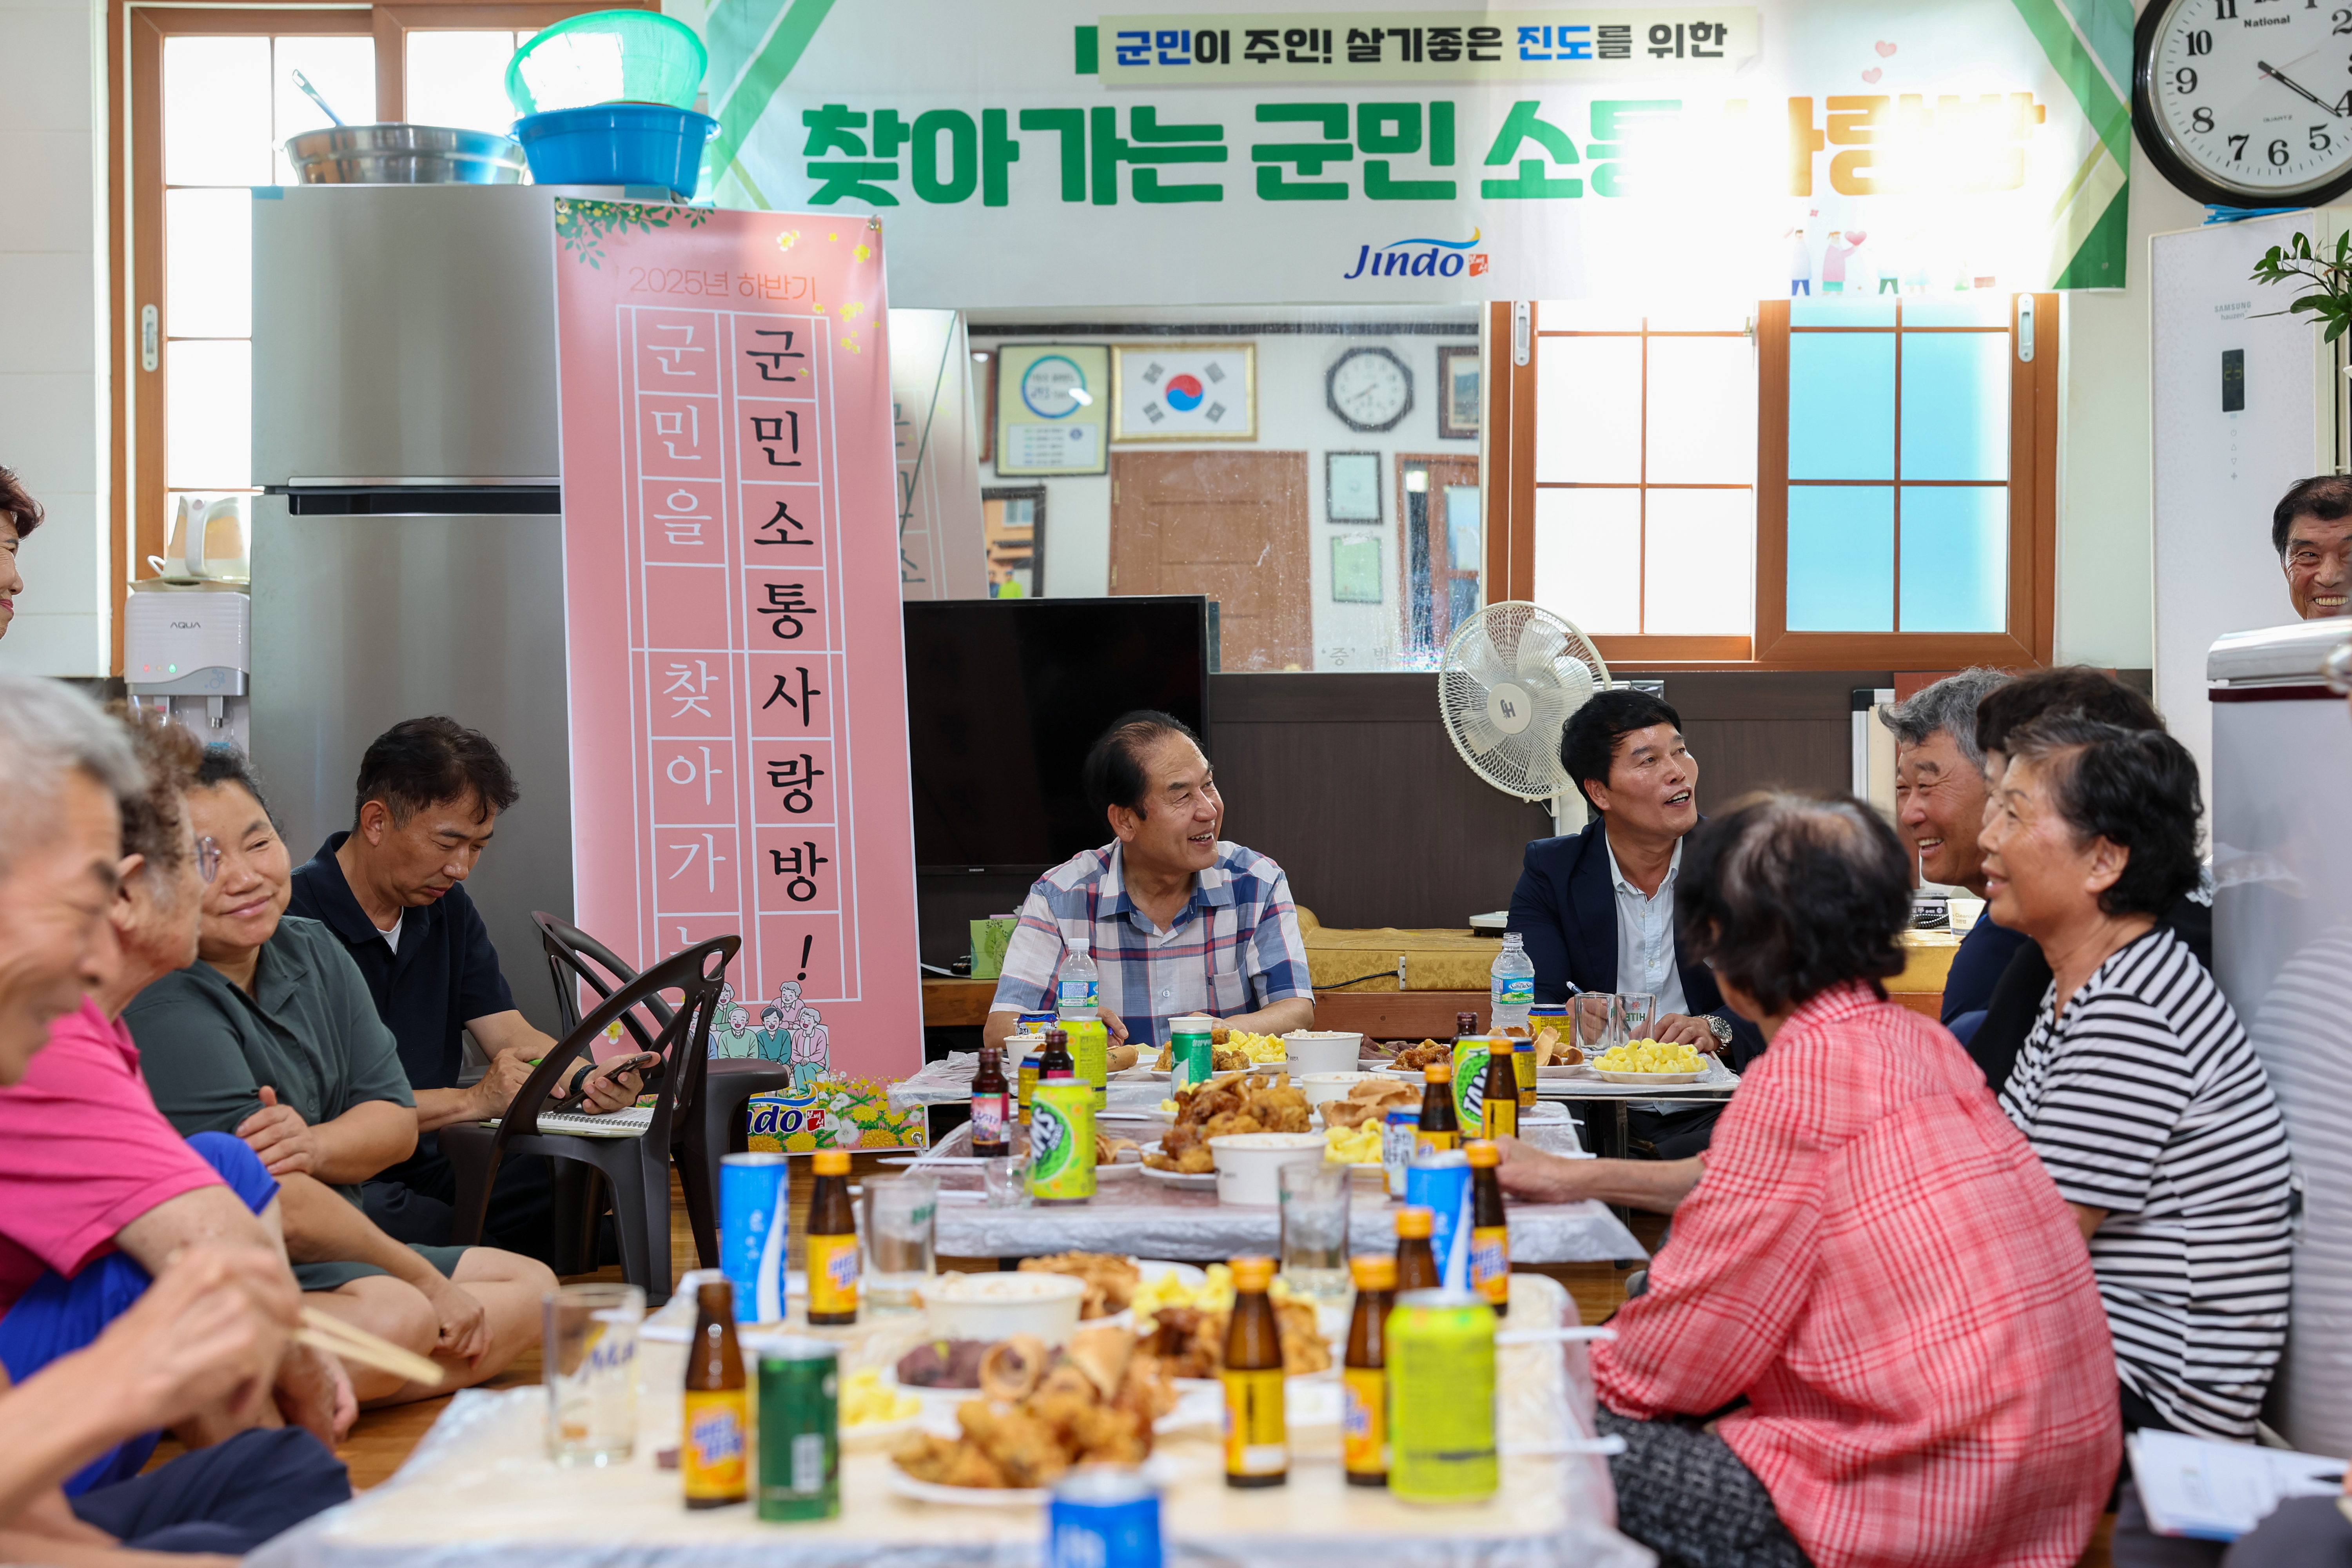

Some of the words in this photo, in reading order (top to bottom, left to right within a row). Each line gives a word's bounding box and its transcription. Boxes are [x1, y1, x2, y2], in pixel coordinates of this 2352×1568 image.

[2244, 15, 2290, 28] National
[1115, 29, 1230, 66] 군민이
[1243, 29, 1332, 64] 주인!
[1346, 25, 1503, 63] 살기좋은
[1517, 24, 1633, 61] 진도를
[1648, 21, 1728, 60] 위한
[2186, 30, 2213, 56] 10
[2176, 67, 2198, 94] 9
[2192, 107, 2214, 134] 8
[2228, 134, 2250, 161] 7
[2309, 123, 2331, 151] 5
[802, 103, 1227, 207] 찾아가는
[1251, 100, 1457, 201] 군민
[2268, 139, 2289, 166] 6
[1344, 245, 1464, 279] Jindo
[628, 267, 729, 297] 2025년
[737, 273, 817, 302] 하반기
[2214, 301, 2251, 313] SAMSUNG
[646, 324, 712, 546] 군민을
